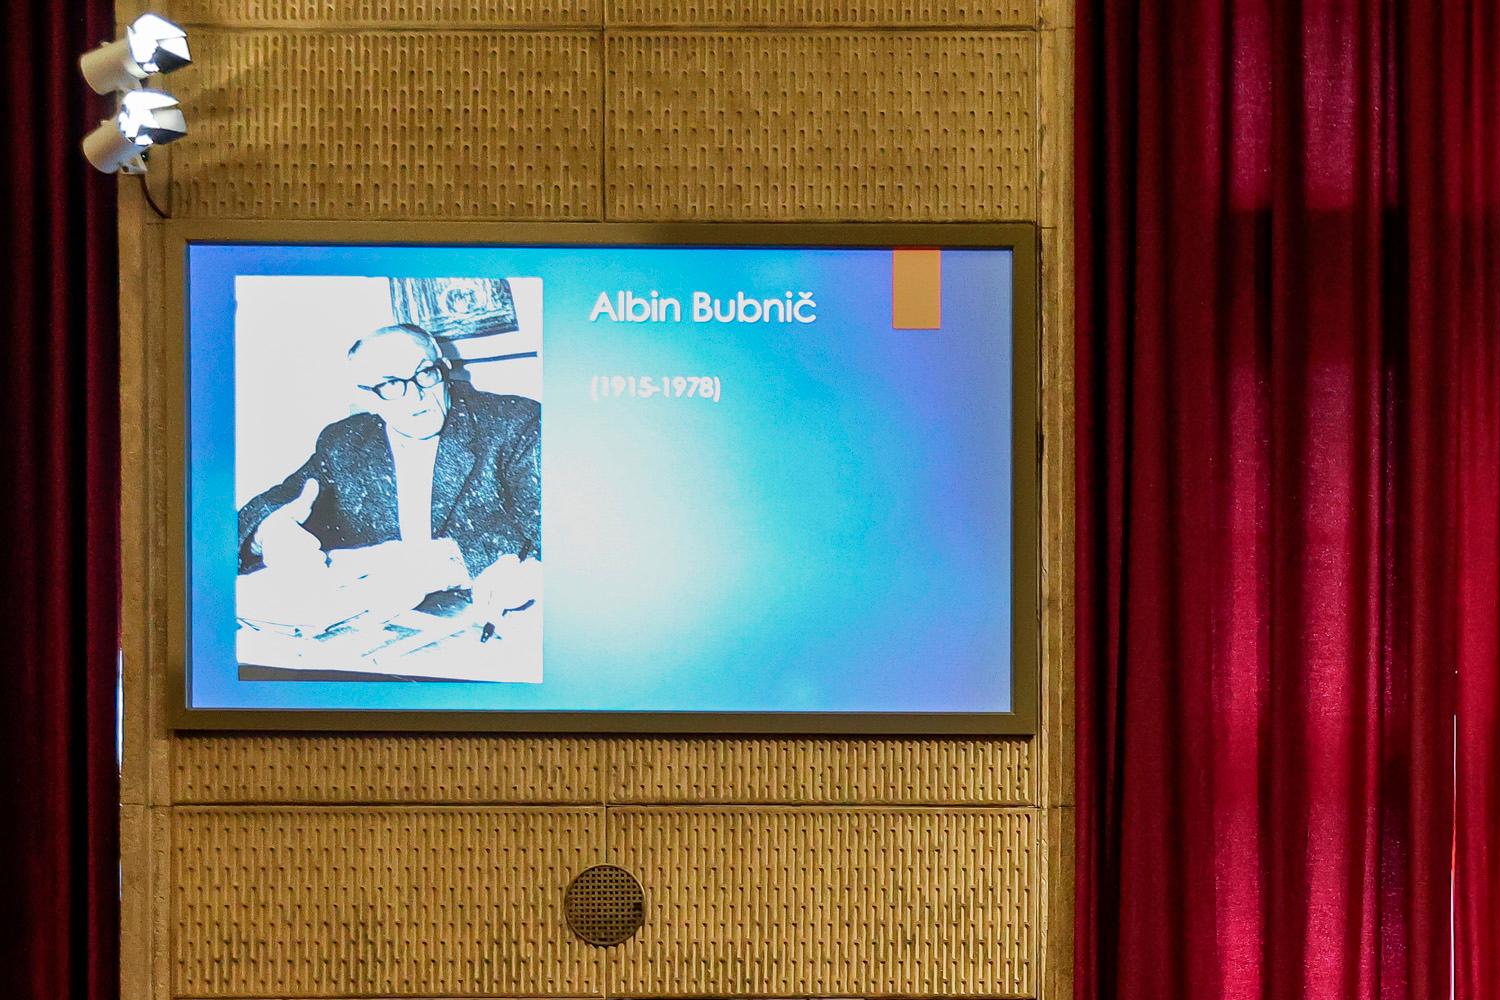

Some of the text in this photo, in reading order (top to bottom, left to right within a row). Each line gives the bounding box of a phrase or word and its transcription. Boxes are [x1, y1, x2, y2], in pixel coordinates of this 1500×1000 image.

[589, 290, 817, 323] Albin Bubnič
[591, 376, 721, 402] (1915-1978)
